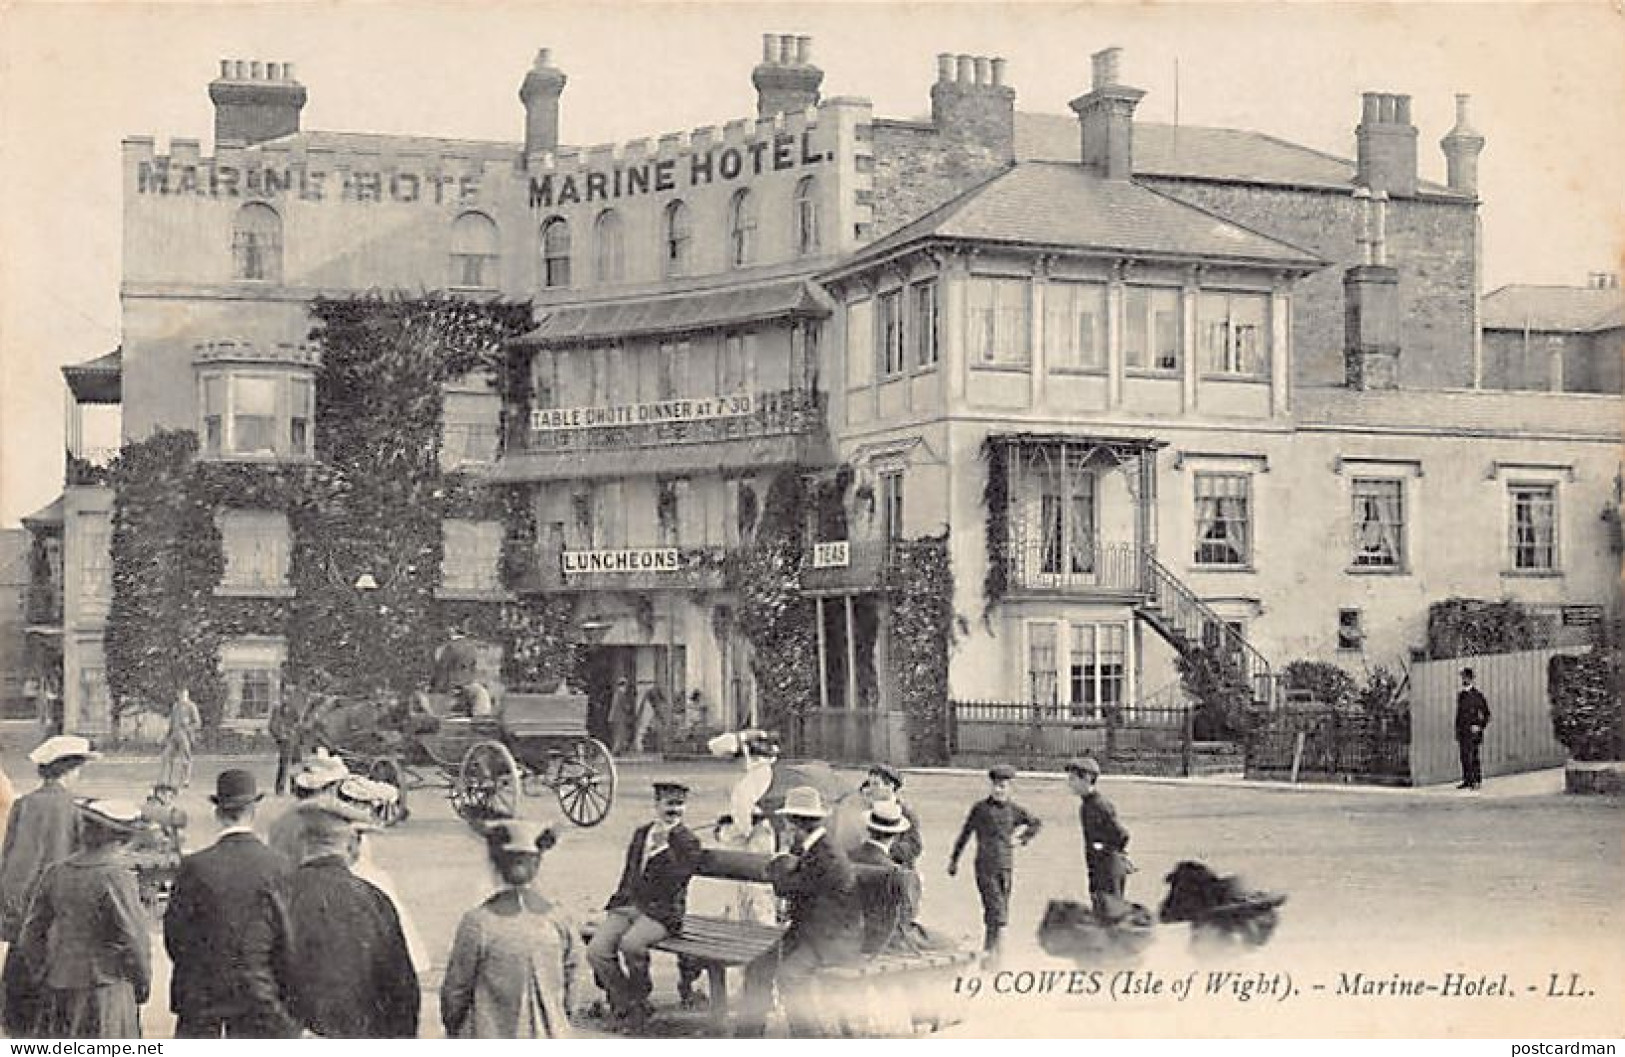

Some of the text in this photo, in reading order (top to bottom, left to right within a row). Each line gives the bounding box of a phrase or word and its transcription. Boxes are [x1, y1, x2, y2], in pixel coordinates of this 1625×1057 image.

[138, 156, 327, 199] MARINE
[529, 127, 834, 208] MARINE HOTEL.
[533, 409, 581, 427] TABLE
[639, 401, 692, 422] DINNER
[696, 401, 711, 415] AT
[565, 551, 677, 570] LUNCHEONS
[817, 543, 845, 564] TEAS
